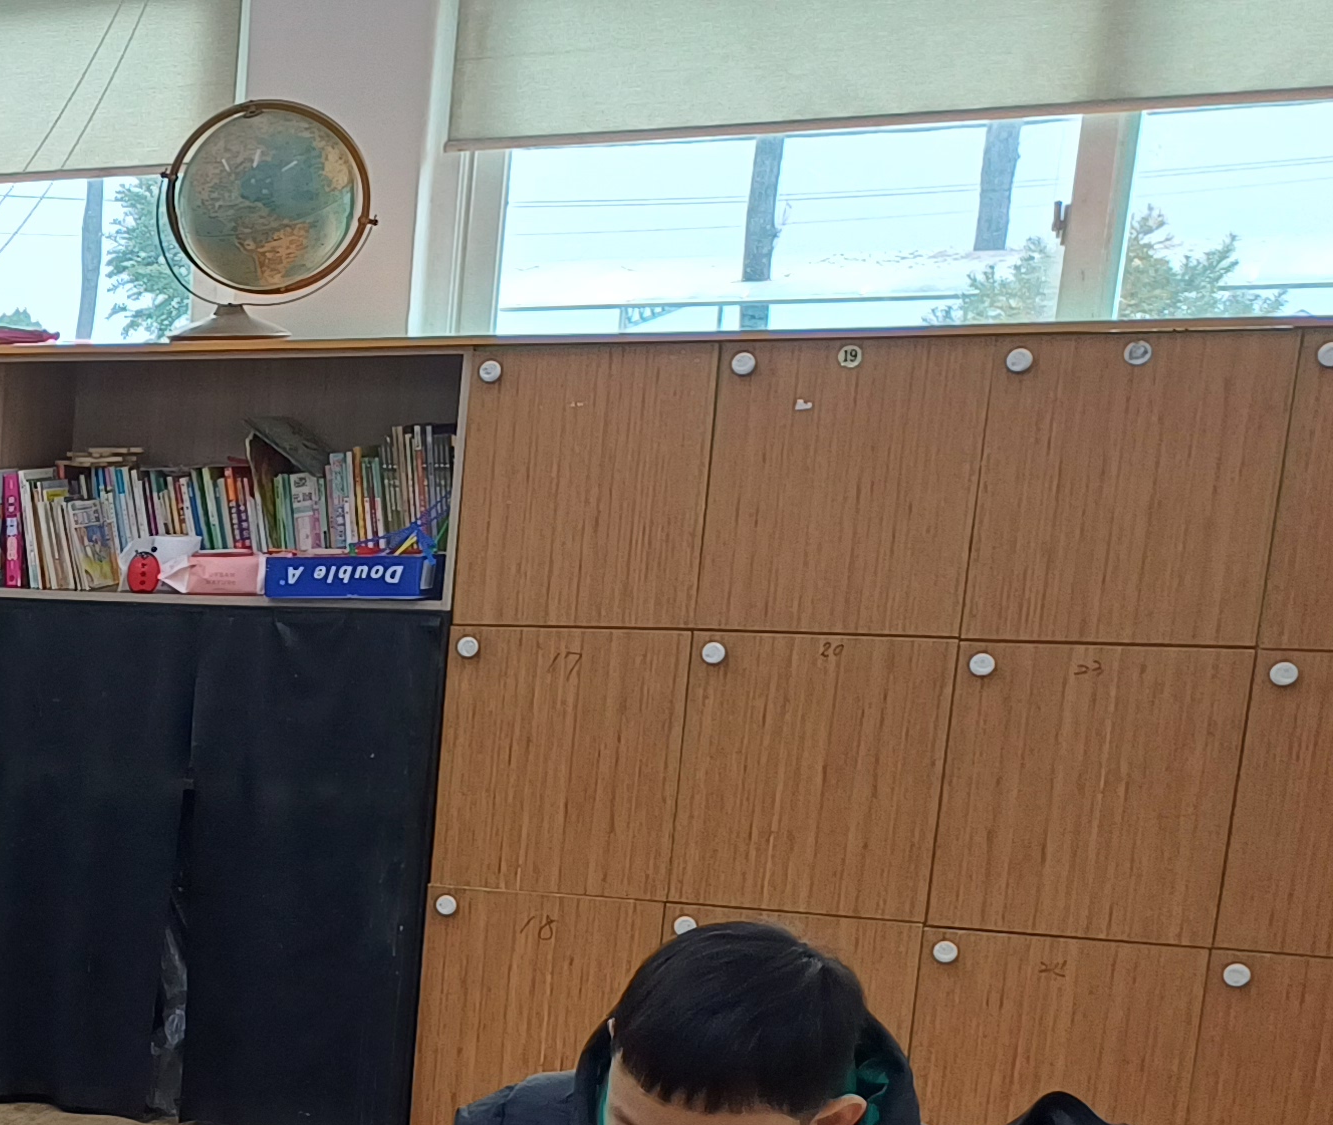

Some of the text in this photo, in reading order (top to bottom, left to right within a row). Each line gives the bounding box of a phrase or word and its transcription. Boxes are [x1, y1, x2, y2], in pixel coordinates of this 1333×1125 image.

[842, 348, 859, 363] 19
[287, 565, 404, 584] Double A
[820, 641, 844, 658] 20
[546, 651, 583, 682] 17
[519, 914, 557, 941] 18
